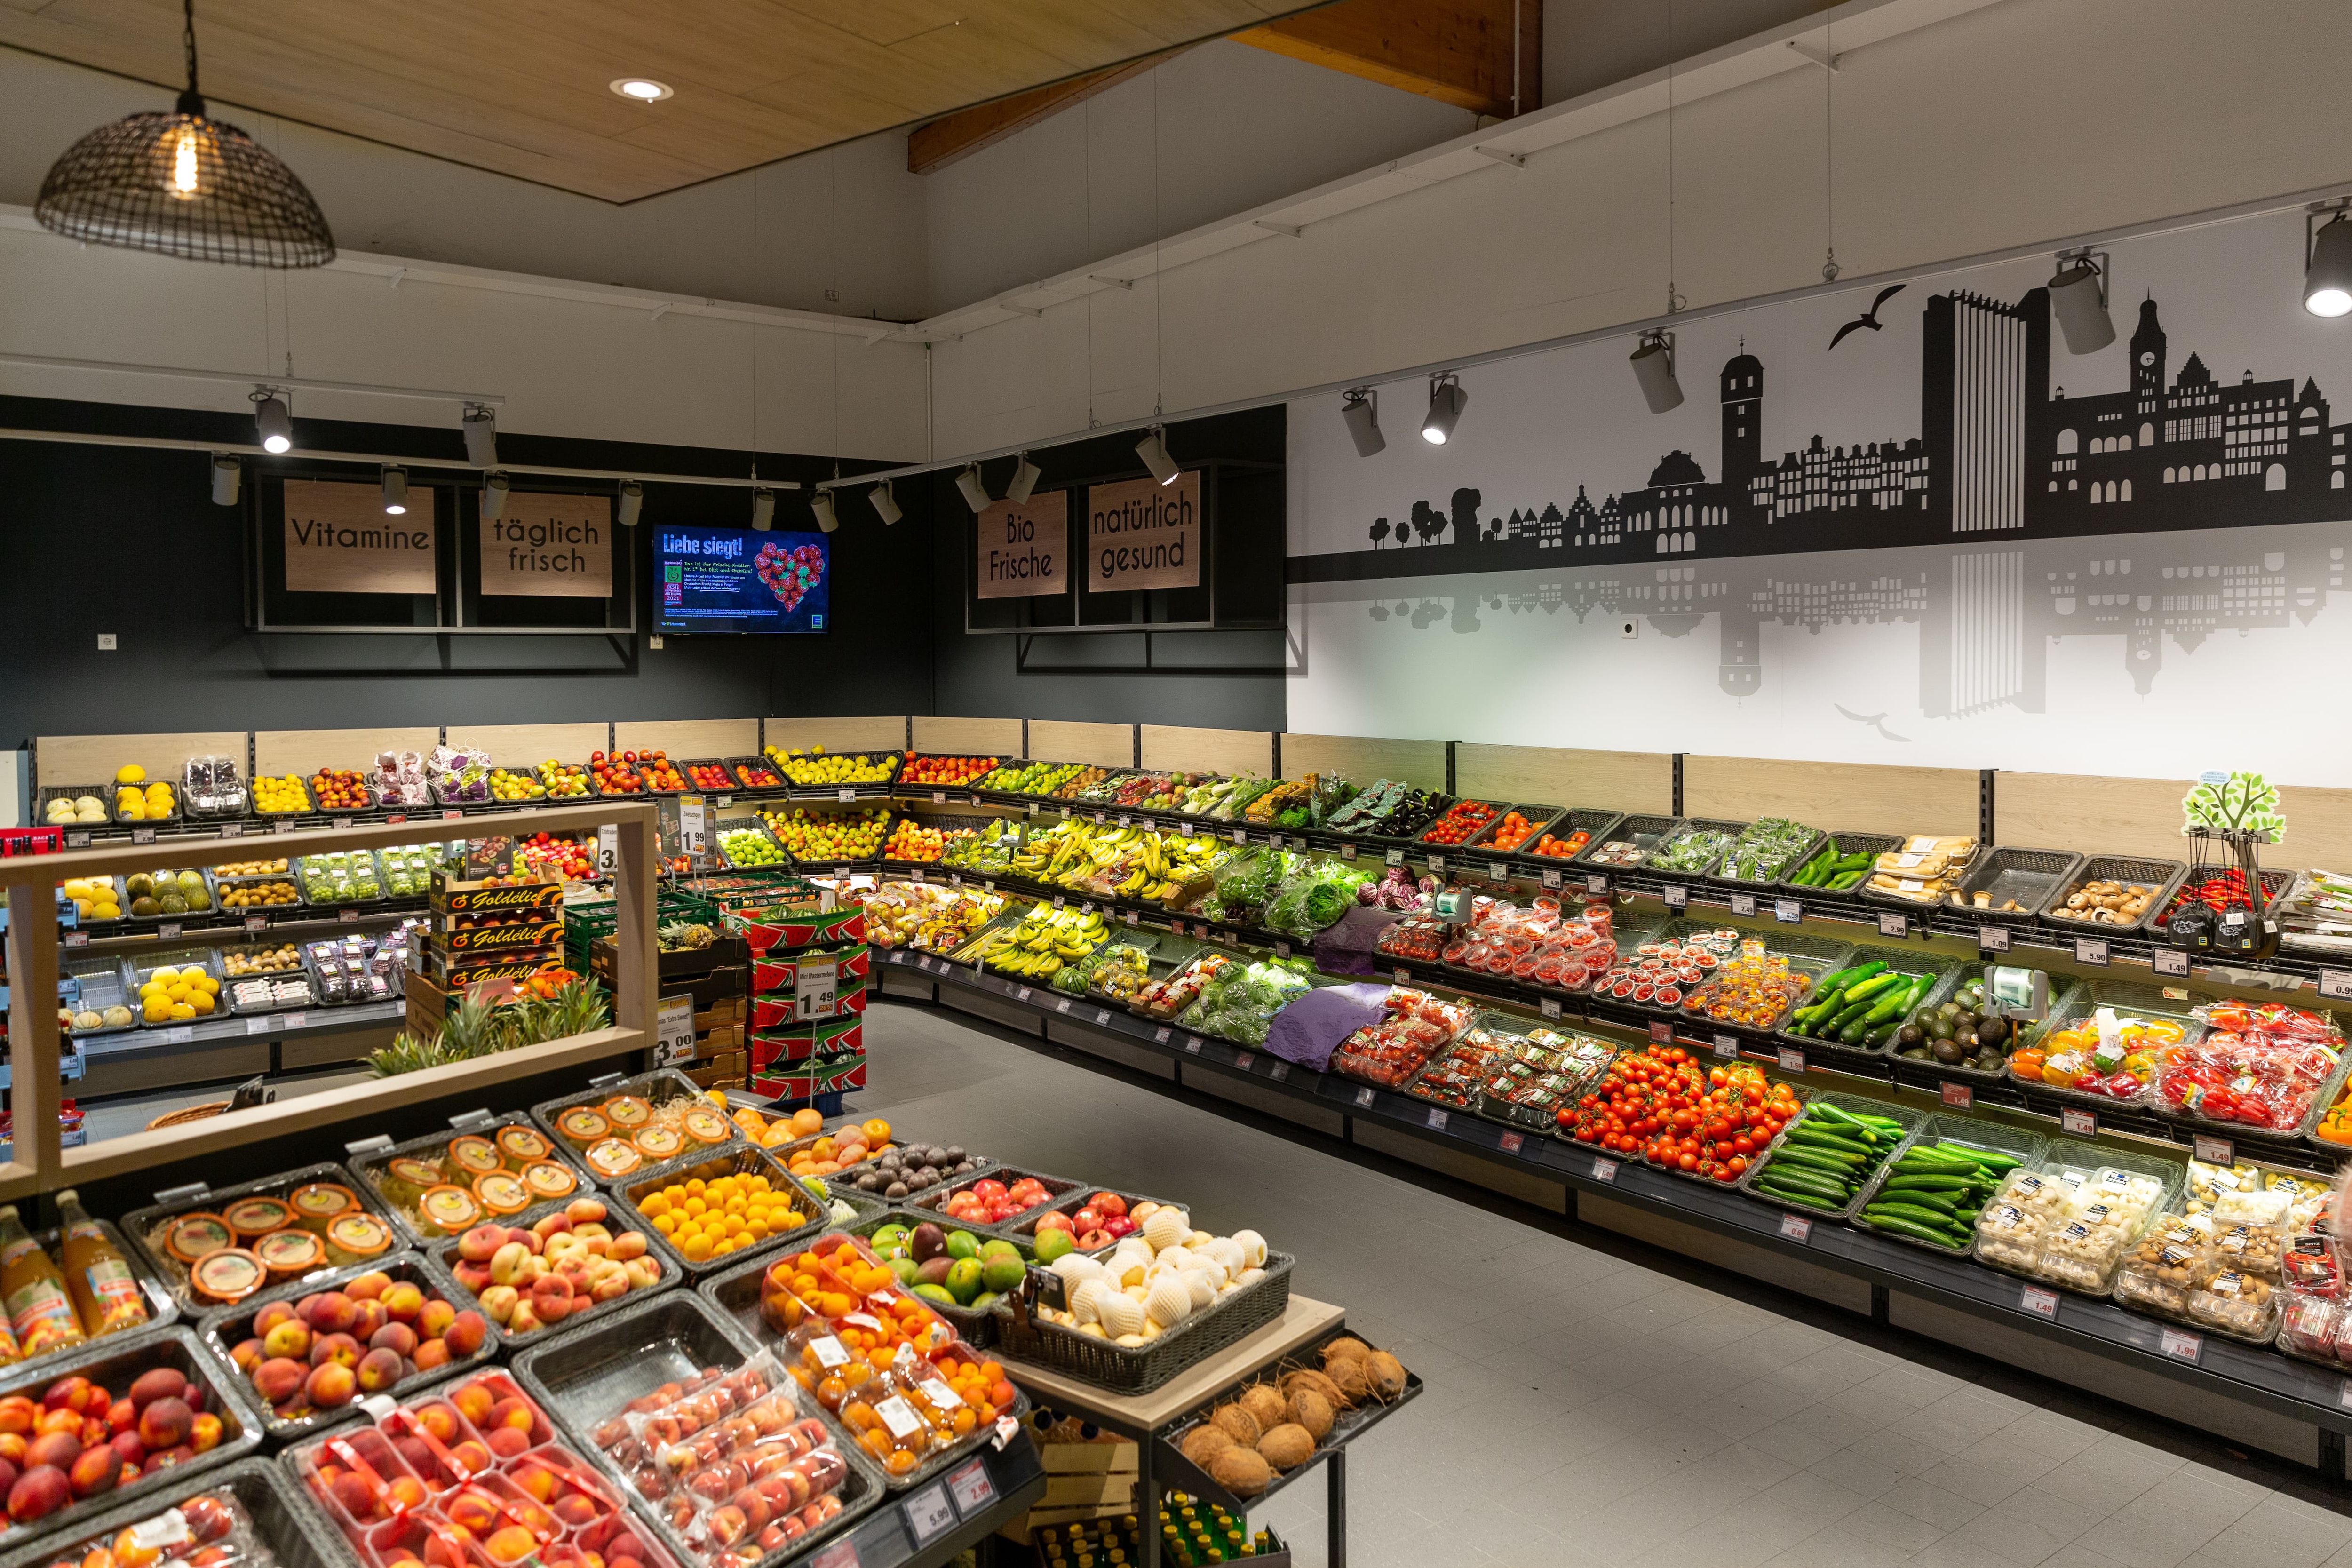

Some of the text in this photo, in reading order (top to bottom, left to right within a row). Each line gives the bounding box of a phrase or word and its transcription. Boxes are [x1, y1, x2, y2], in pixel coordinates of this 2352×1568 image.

[1094, 490, 1192, 534] natürlich
[291, 518, 430, 550] Vitamine
[494, 518, 599, 547] täglich
[1007, 513, 1034, 544] Bio
[663, 534, 742, 559] Liebe siegt!
[1101, 531, 1184, 579] gesund
[509, 548, 586, 573] frisch
[990, 547, 1052, 581] Frische
[472, 890, 546, 909] Goldélice
[473, 927, 547, 947] Goldélice
[472, 965, 540, 981] Goldéli
[2168, 963, 2185, 972] 1.49
[1789, 1061, 1802, 1069] 1.59
[1953, 1097, 1969, 1105] 1.49
[2076, 1123, 2092, 1132] 1.49
[2210, 1151, 2229, 1162] 1.49
[1601, 1170, 1612, 1178] 1.49
[1790, 1227, 1805, 1237] 0.69
[2035, 1302, 2052, 1313] 1.49
[2176, 1345, 2195, 1356] 1.99
[971, 1480, 990, 1500] 2.99
[929, 1506, 950, 1526] 5.99
